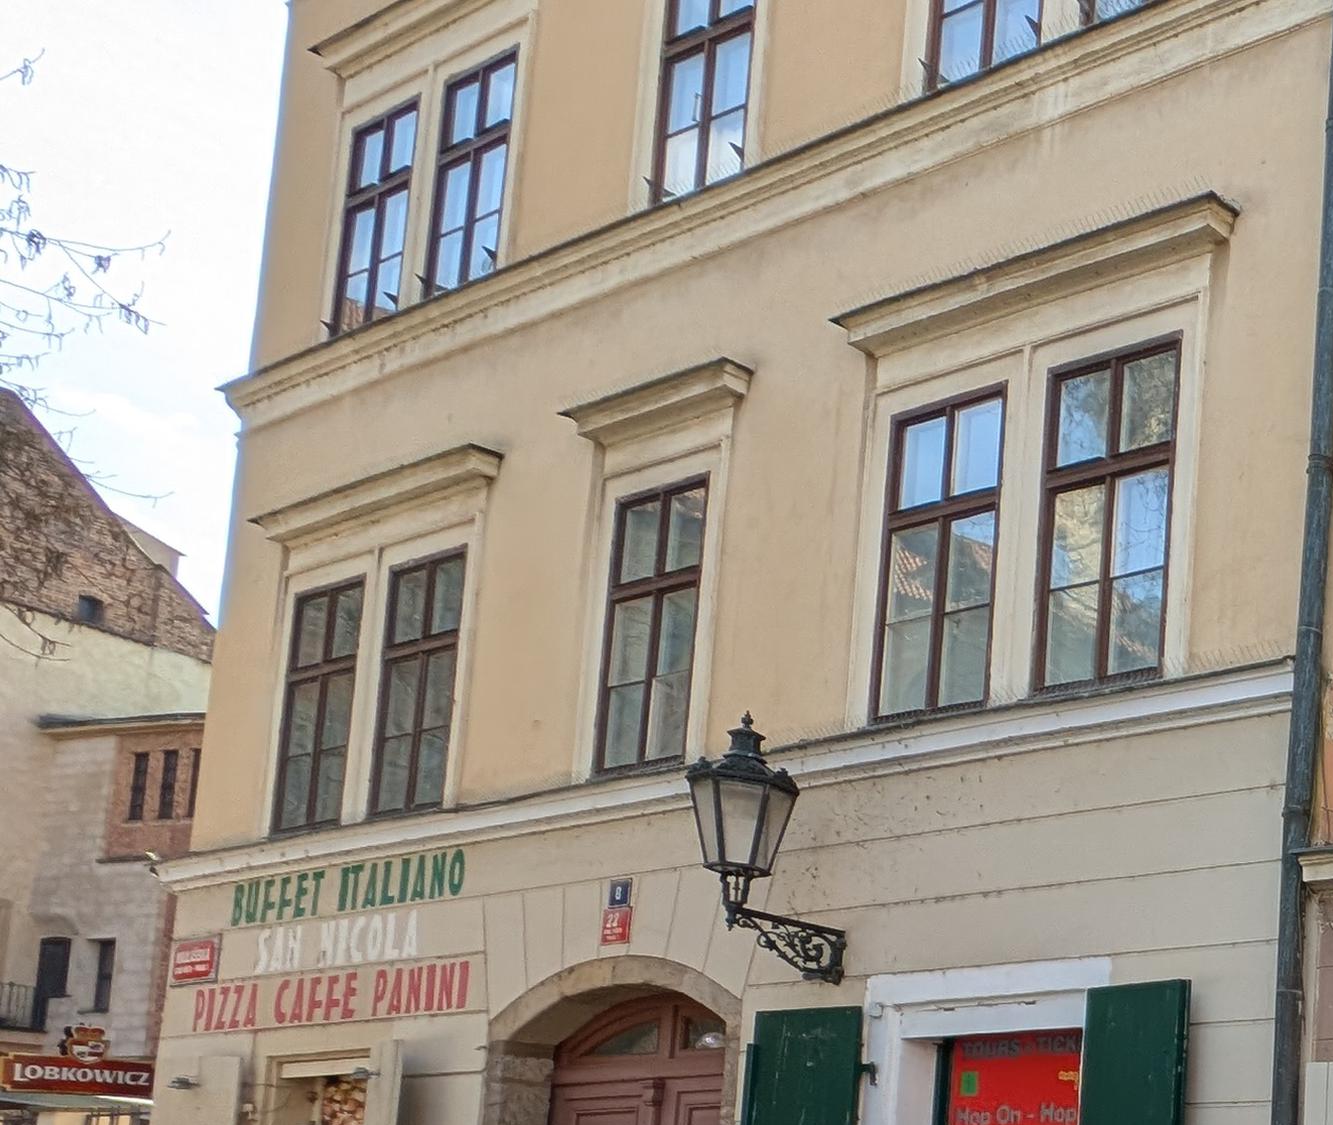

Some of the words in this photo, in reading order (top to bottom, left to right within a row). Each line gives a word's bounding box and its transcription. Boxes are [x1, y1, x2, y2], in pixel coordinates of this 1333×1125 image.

[231, 870, 325, 926] BUFFET
[337, 849, 466, 912] ITALIANO
[255, 925, 303, 975] SAN
[317, 909, 418, 968] NICOLA
[192, 982, 258, 1032] PIZZA
[274, 971, 358, 1025] CAFFE
[371, 960, 470, 1017] PANINI
[1037, 1036, 1081, 1053] TICK
[14, 1063, 150, 1086] LOBKOWICZ
[996, 1105, 1022, 1125] On
[1040, 1101, 1077, 1125] Hop
